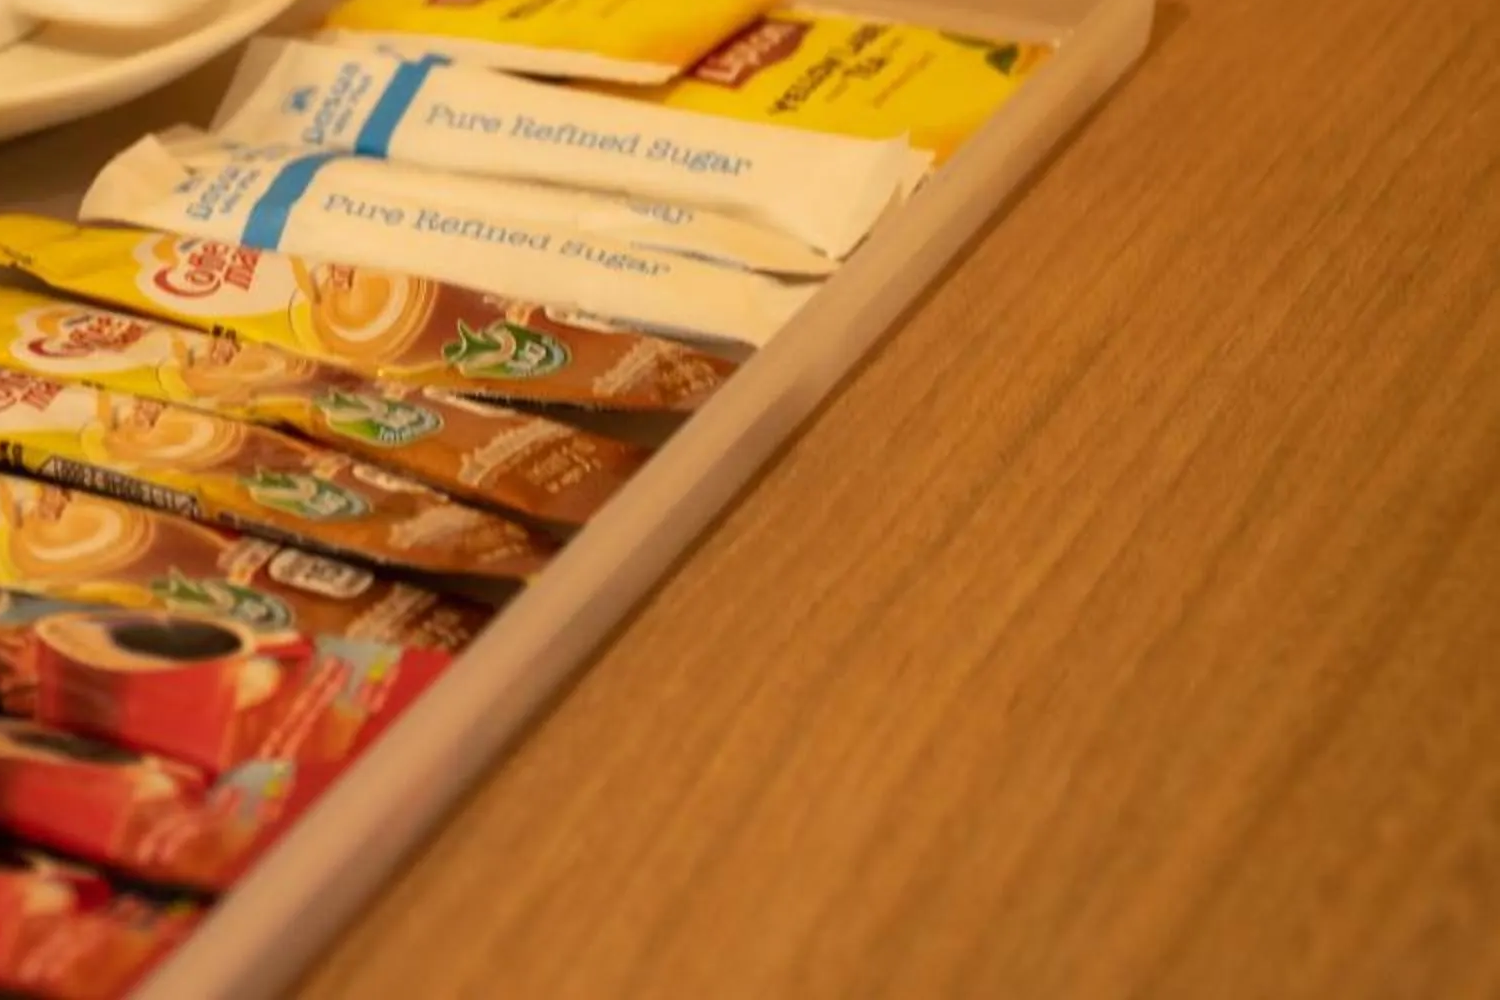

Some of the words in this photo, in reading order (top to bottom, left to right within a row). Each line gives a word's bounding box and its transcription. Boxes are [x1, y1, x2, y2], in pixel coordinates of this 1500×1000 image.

[424, 102, 501, 134] Pure
[510, 114, 641, 155] Refined
[646, 138, 754, 177] Sugar
[323, 192, 406, 227] Pure
[412, 208, 552, 251] Refined
[559, 238, 672, 277] Sugar
